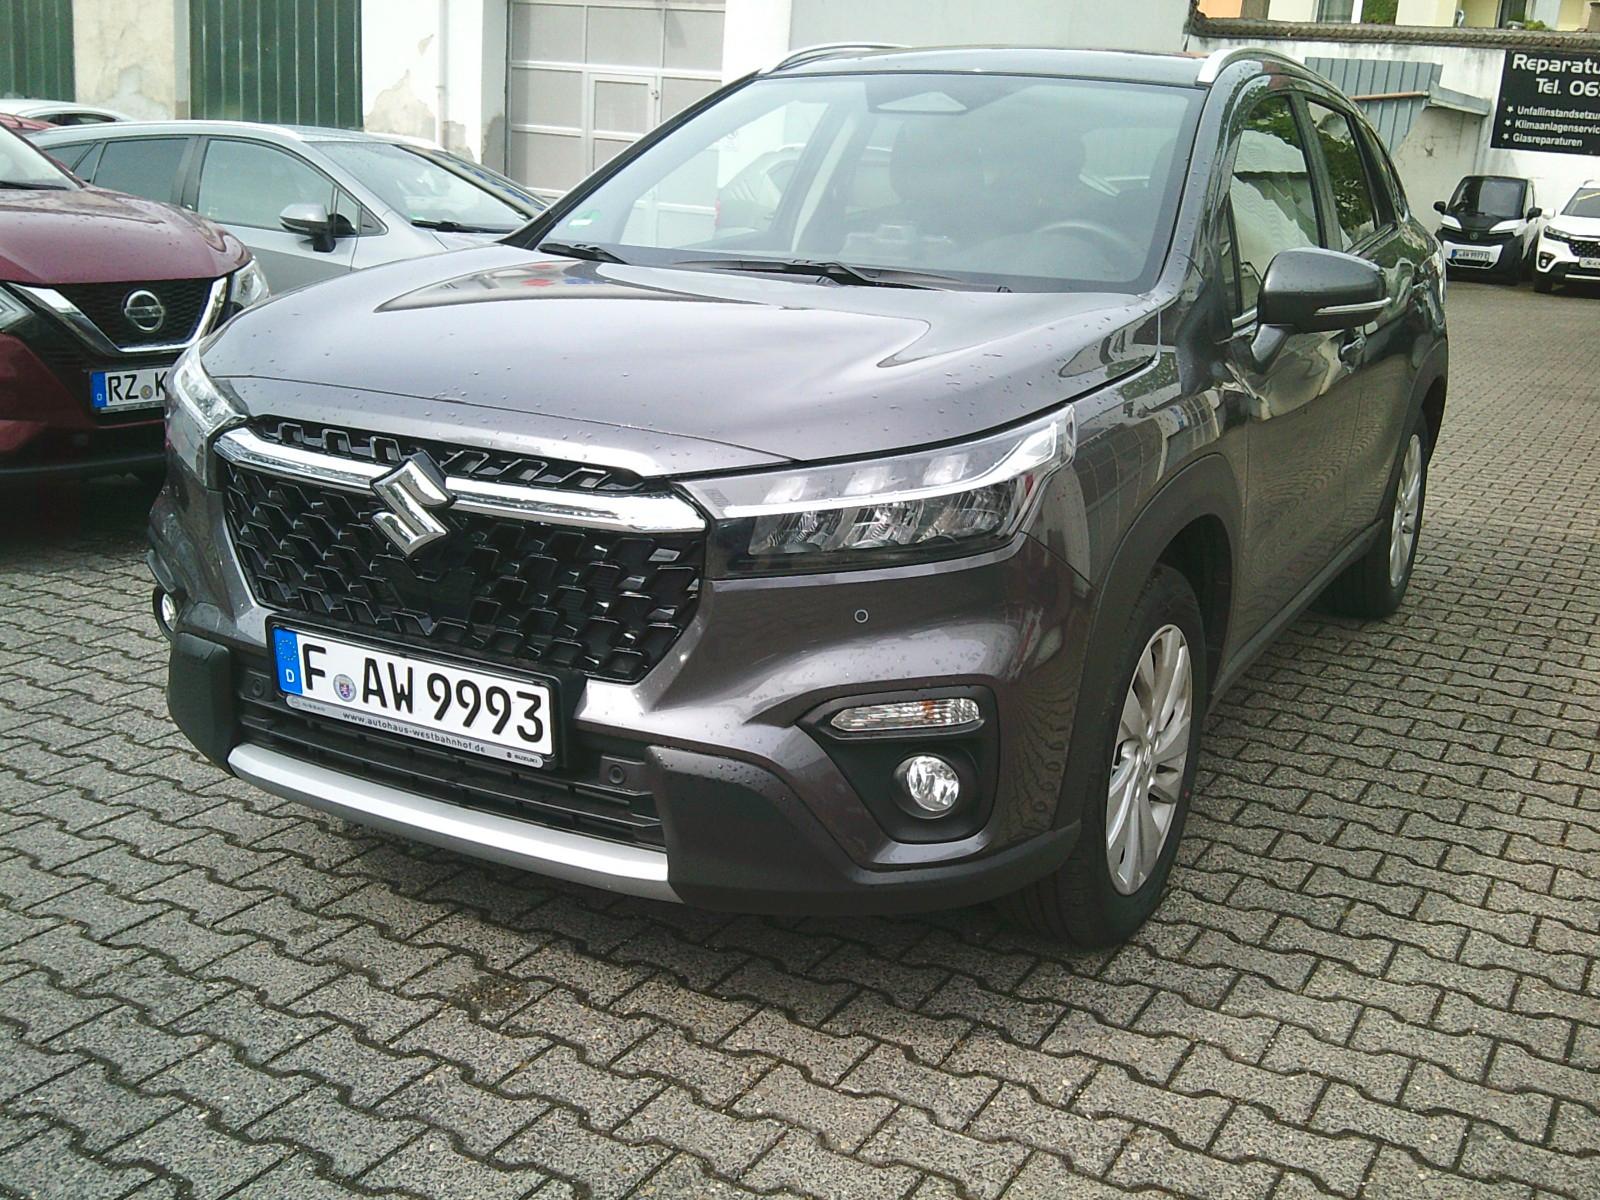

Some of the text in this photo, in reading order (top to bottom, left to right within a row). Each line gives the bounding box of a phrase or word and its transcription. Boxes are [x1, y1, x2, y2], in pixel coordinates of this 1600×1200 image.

[1536, 77, 1600, 97] Tel. 06
[1512, 133, 1583, 147] Glasreparaturen
[108, 374, 139, 402] RZ
[285, 668, 296, 683] D
[302, 643, 544, 743] F AW 9993
[342, 711, 486, 753] www.autohaus-westbahnhof.de
